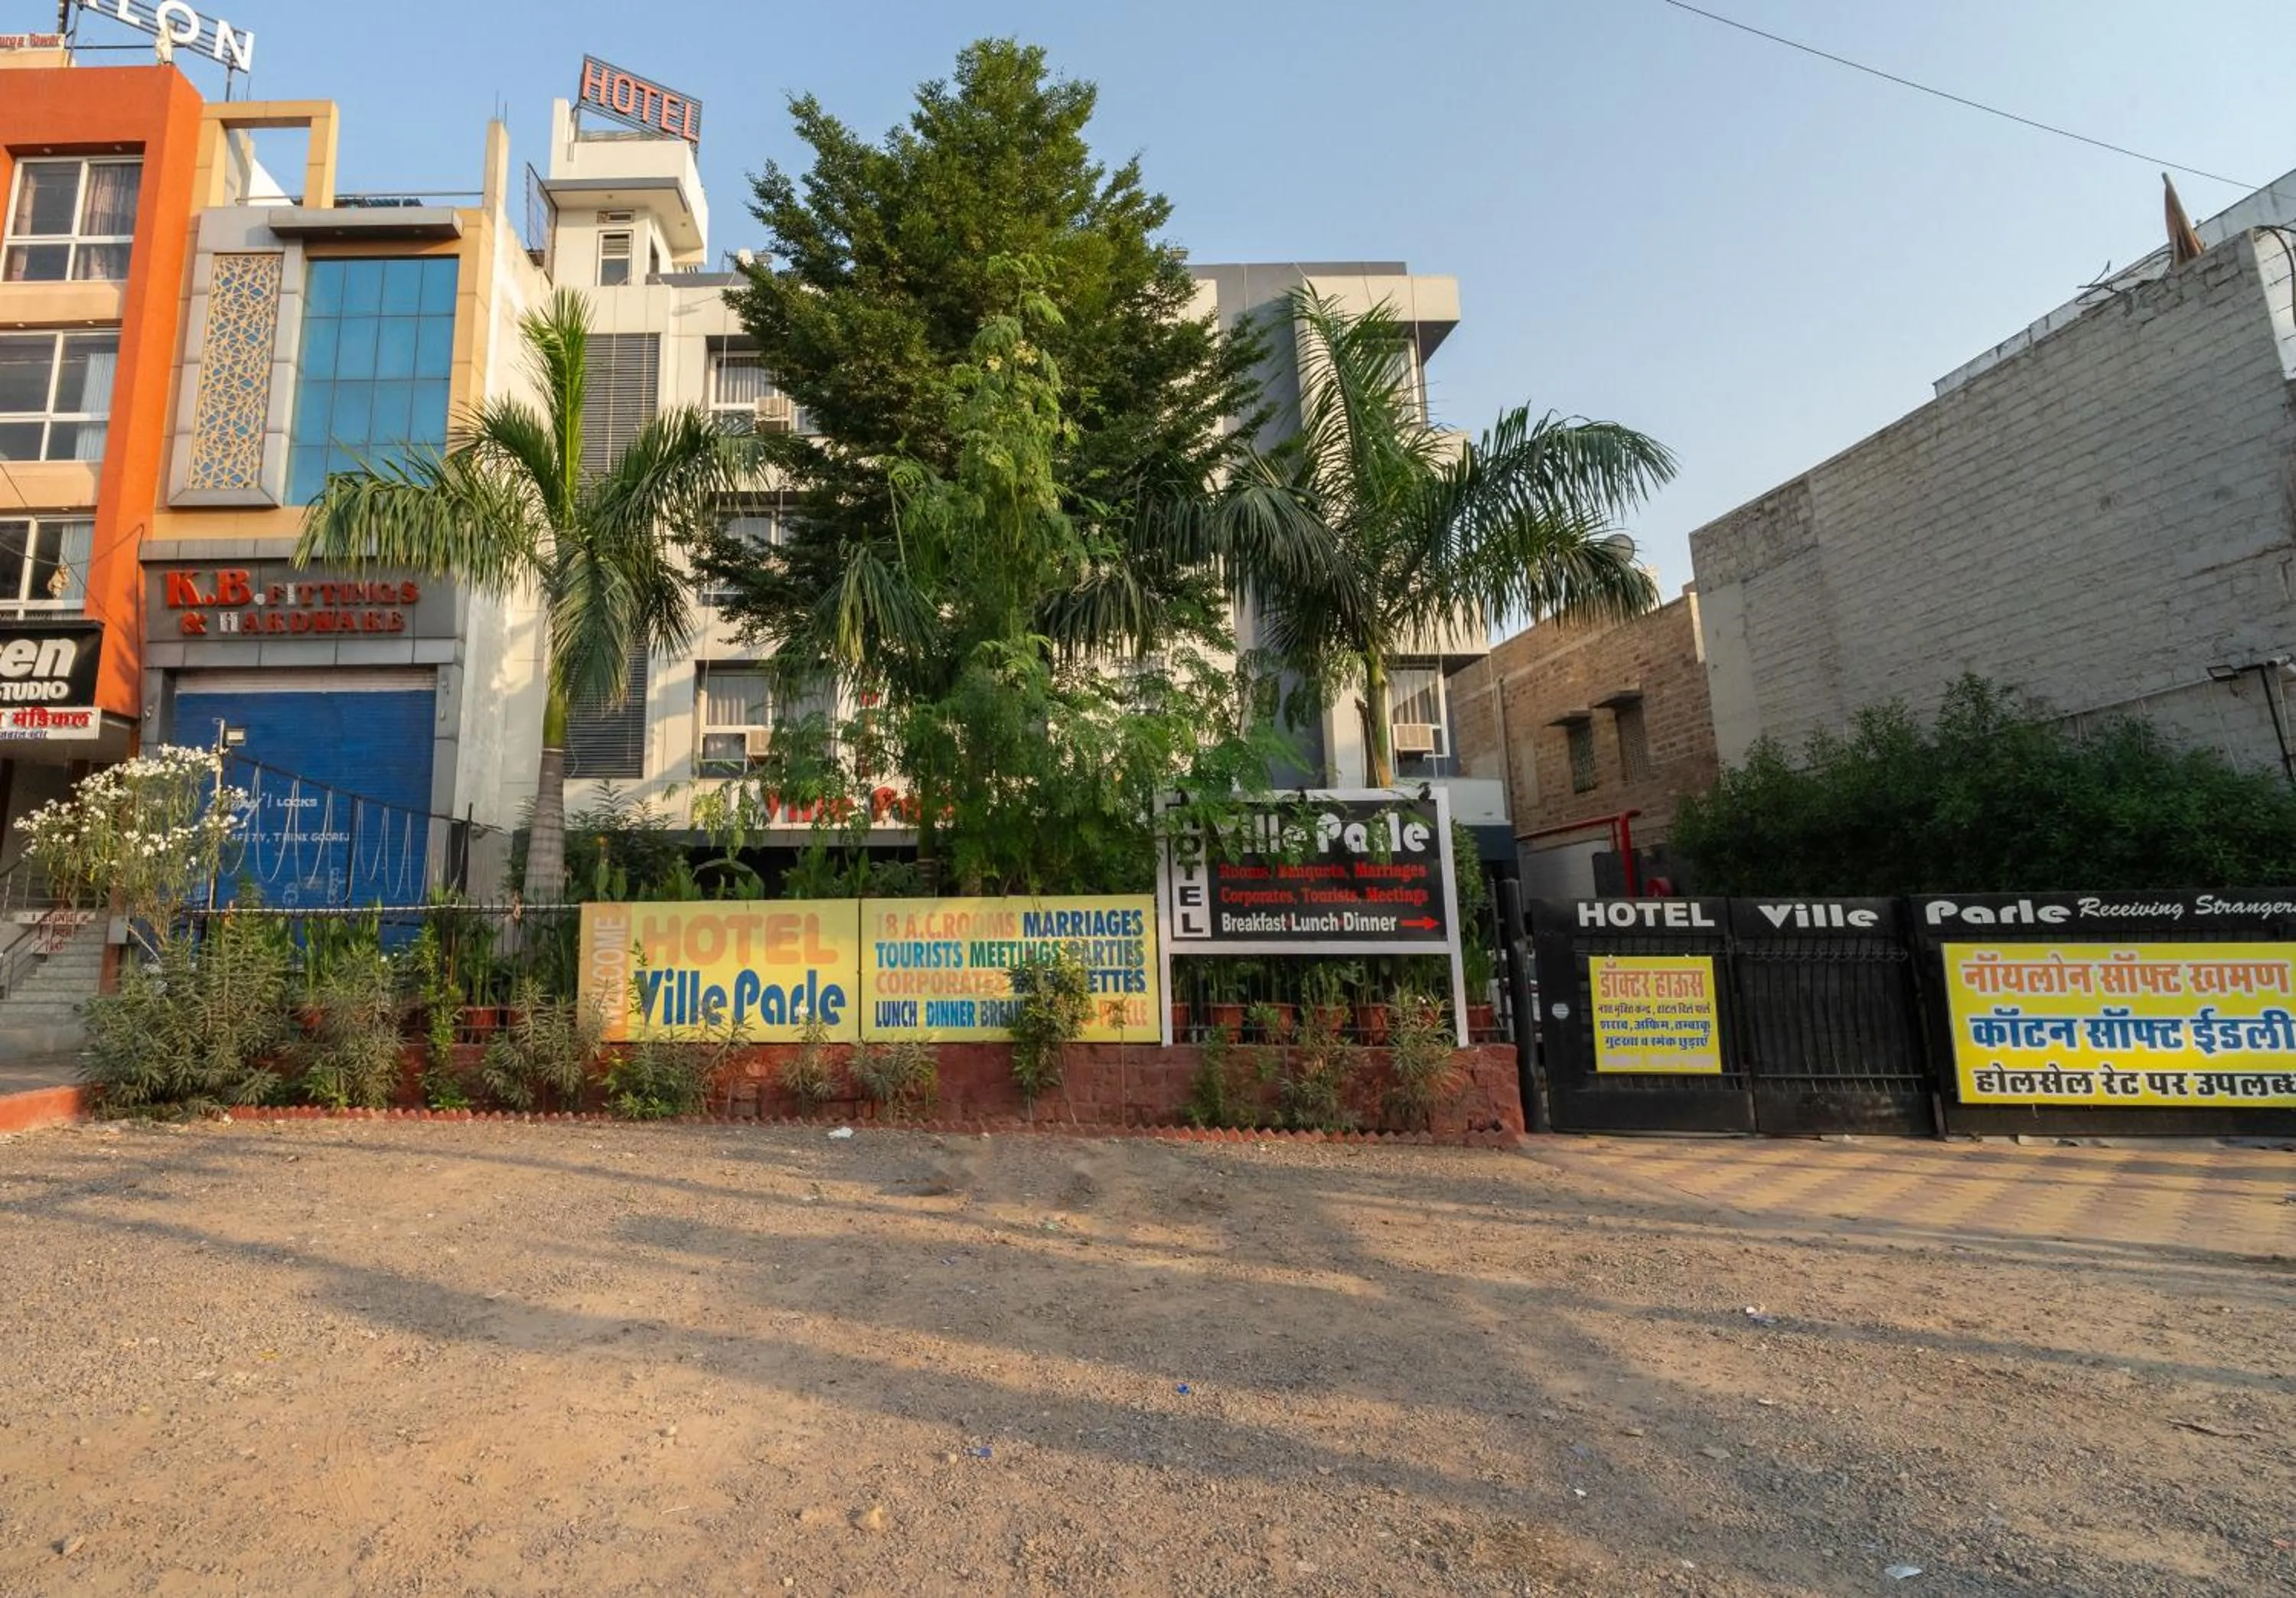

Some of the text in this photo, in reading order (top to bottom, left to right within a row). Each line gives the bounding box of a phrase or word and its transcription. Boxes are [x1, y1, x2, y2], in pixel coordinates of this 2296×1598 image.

[83, 0, 254, 72] LON
[582, 60, 699, 142] HOTEL
[181, 611, 406, 635] & HARDWARE
[0, 638, 77, 677] en
[0, 680, 69, 700] TUDIO
[1316, 812, 1430, 853] Pale
[1355, 862, 1428, 882] Marriages
[1365, 886, 1429, 906] Meetings
[1578, 902, 1715, 928] HOTEL
[1758, 904, 1879, 928] Ville
[1926, 898, 2071, 925] Parle
[2077, 897, 2185, 920] Receiving
[1023, 909, 1144, 938] MARRIAGES
[1221, 912, 1397, 931] Breakfast Lunch Dinner
[642, 913, 840, 967] HOTEL
[875, 939, 1144, 968] TOURISTS MEETINGS PARTIES
[1600, 961, 1651, 998] डॉक्टर
[2099, 954, 2181, 993] सॉफ्ट
[2187, 963, 2288, 993] खमण
[634, 968, 727, 1026] Ville
[876, 1001, 917, 1027] LUNCH
[926, 1000, 976, 1027] DINNER
[1969, 1008, 2077, 1048] कॉटन
[2085, 1008, 2183, 1048] सॉफ्ट
[1974, 1062, 2094, 1094] होलसेल
[2101, 1063, 2139, 1094] रेट
[2146, 1071, 2187, 1095] पर
